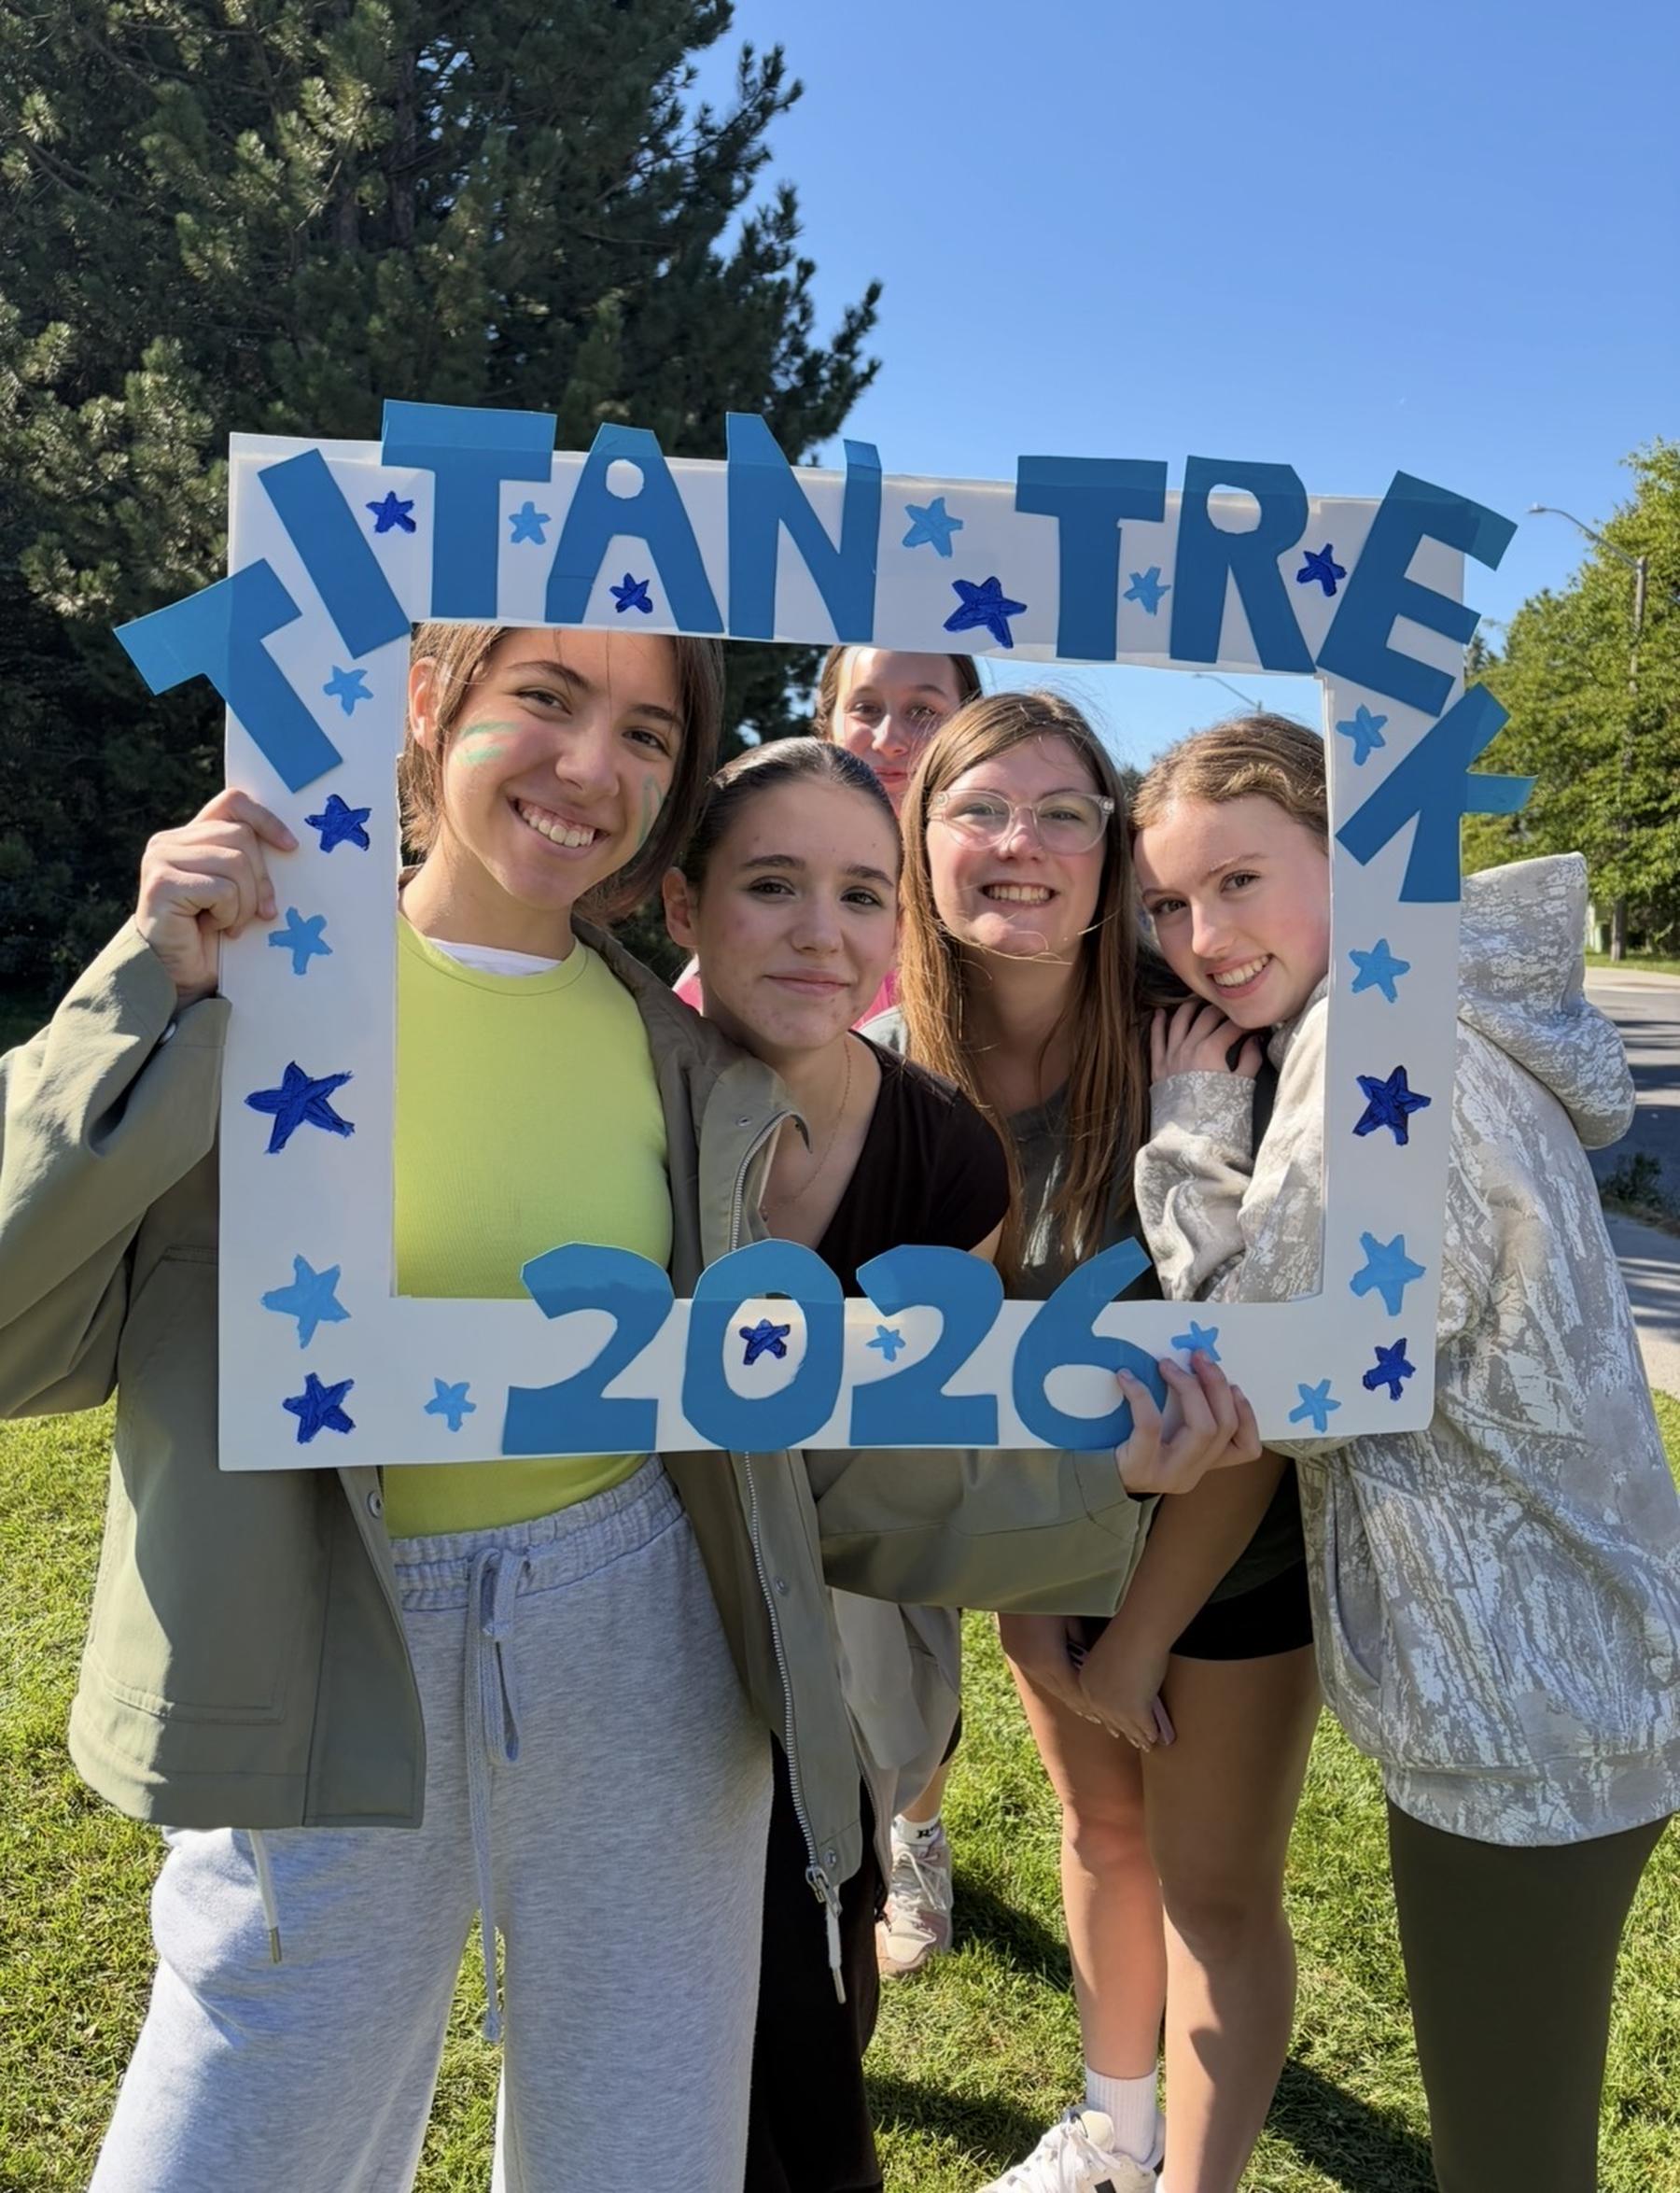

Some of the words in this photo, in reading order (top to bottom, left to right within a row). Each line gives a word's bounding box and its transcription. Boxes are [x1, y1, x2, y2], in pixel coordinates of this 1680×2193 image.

[114, 400, 882, 793] TITAN
[1015, 456, 1537, 903] TREK
[502, 1237, 1168, 1454] 2026
